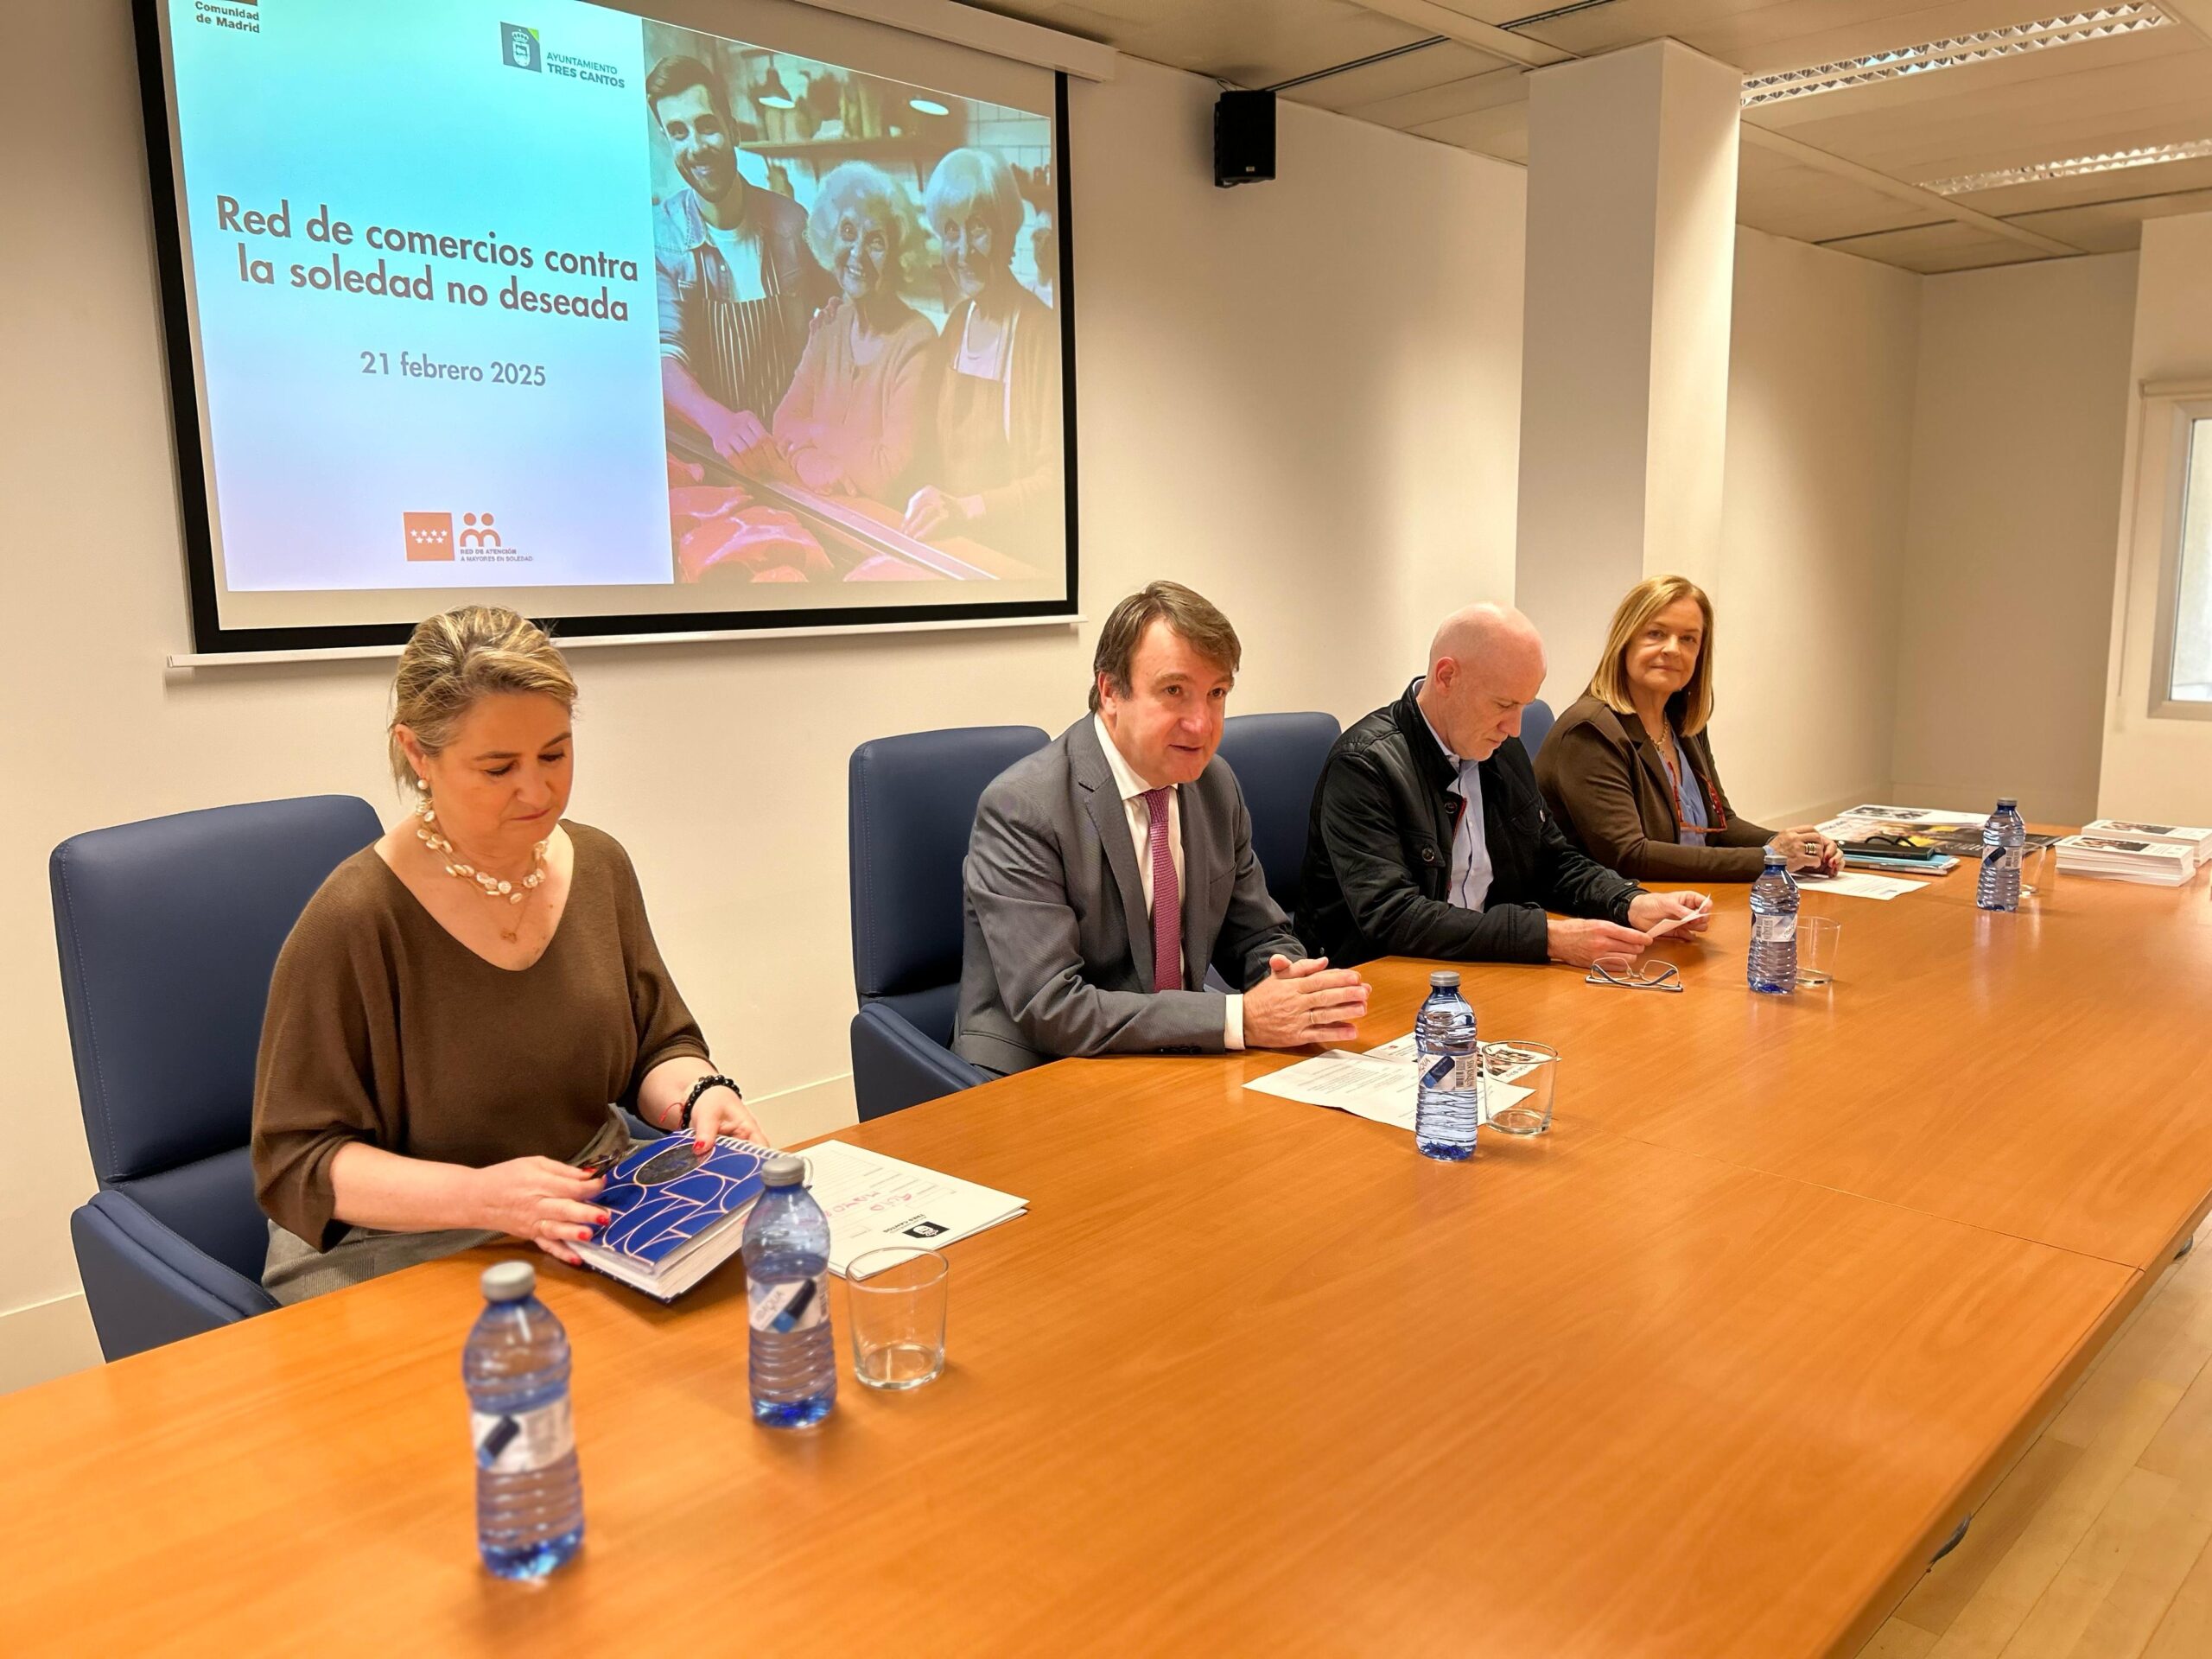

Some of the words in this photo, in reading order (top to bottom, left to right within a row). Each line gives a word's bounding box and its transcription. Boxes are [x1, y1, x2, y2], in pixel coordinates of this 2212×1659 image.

[195, 1, 259, 21] Comunidad
[196, 13, 212, 24] de
[216, 16, 260, 33] Madrid
[546, 52, 618, 75] AYUNTAMIENTO
[547, 62, 577, 78] TRES
[580, 71, 626, 88] CANTOS
[216, 195, 291, 238] Red
[306, 204, 354, 245] de
[365, 225, 534, 270] comercios
[544, 247, 639, 282] contra
[238, 243, 275, 284] la
[289, 253, 434, 301] soledad
[447, 278, 488, 306] no
[499, 276, 629, 322] deseada
[359, 351, 390, 375] 21
[400, 351, 483, 383] febrero
[491, 360, 546, 386] 2025
